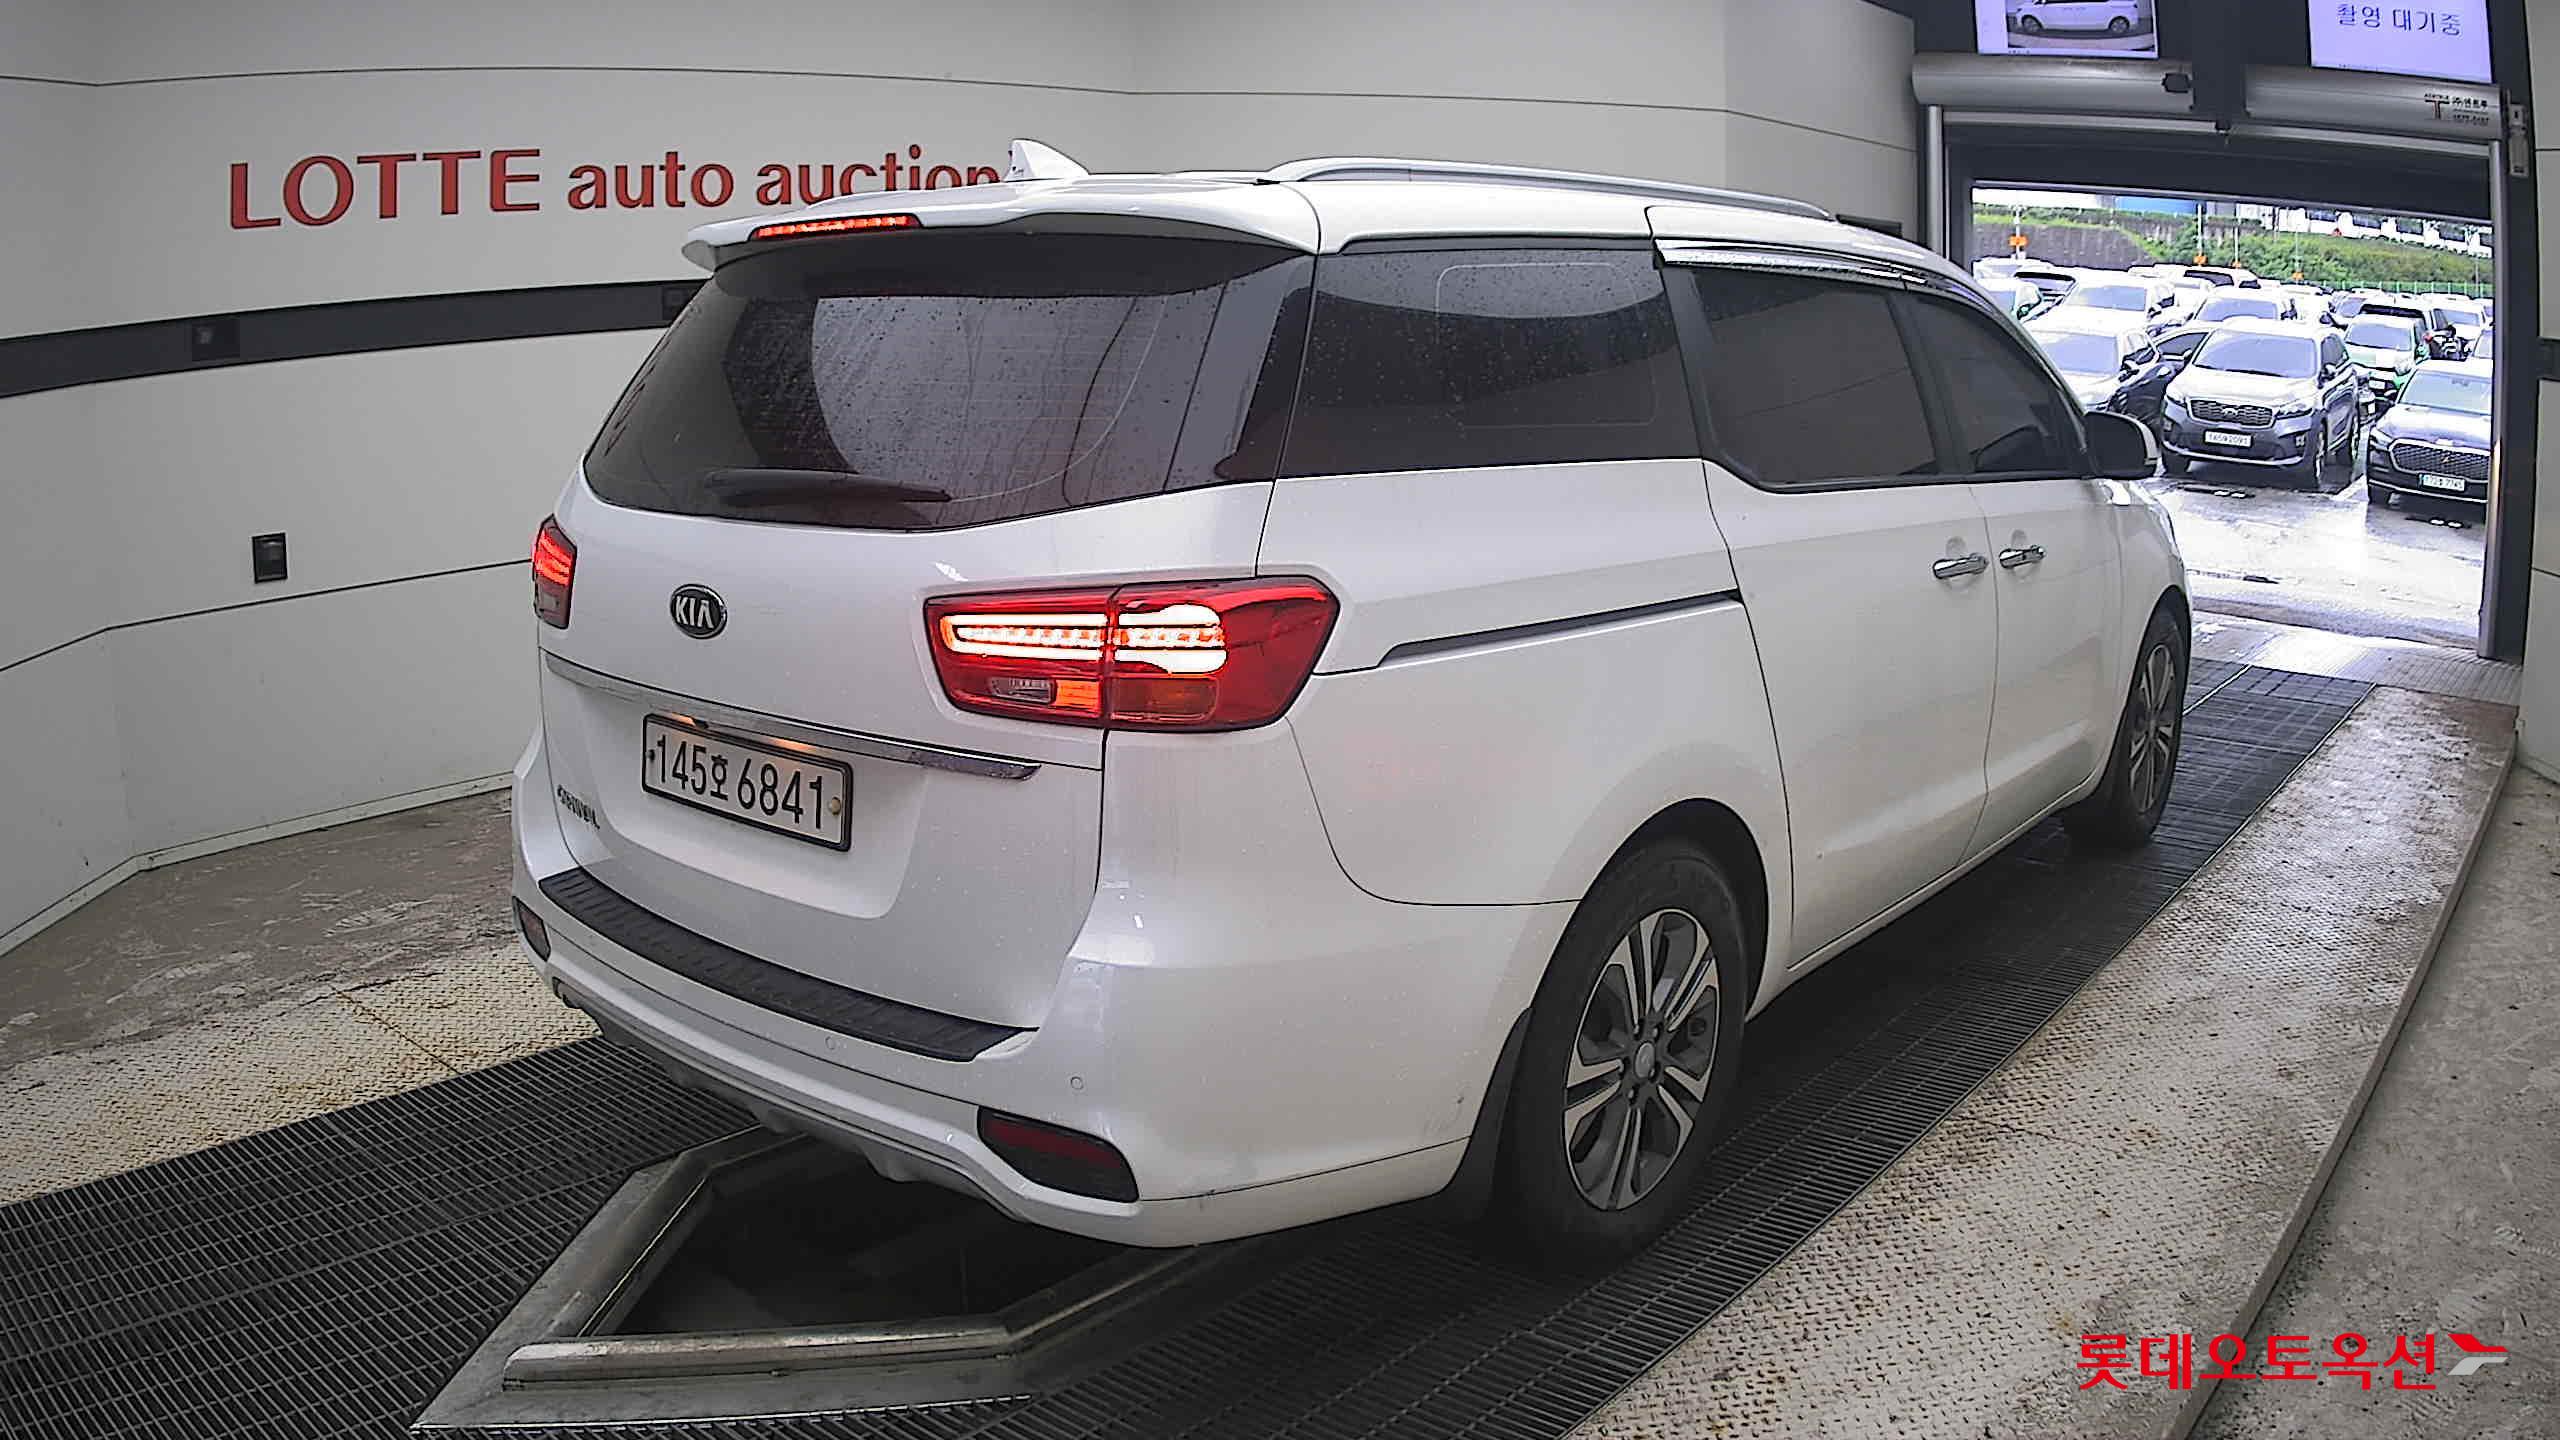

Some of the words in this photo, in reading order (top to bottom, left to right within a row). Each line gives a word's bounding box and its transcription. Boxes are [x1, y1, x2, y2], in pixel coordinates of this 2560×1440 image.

[2392, 9, 2461, 36] 대기중
[231, 149, 540, 229] LOTTE
[567, 151, 734, 209] auto
[675, 595, 715, 629] KIA
[657, 735, 729, 801] 145호
[737, 758, 823, 829] 6841
